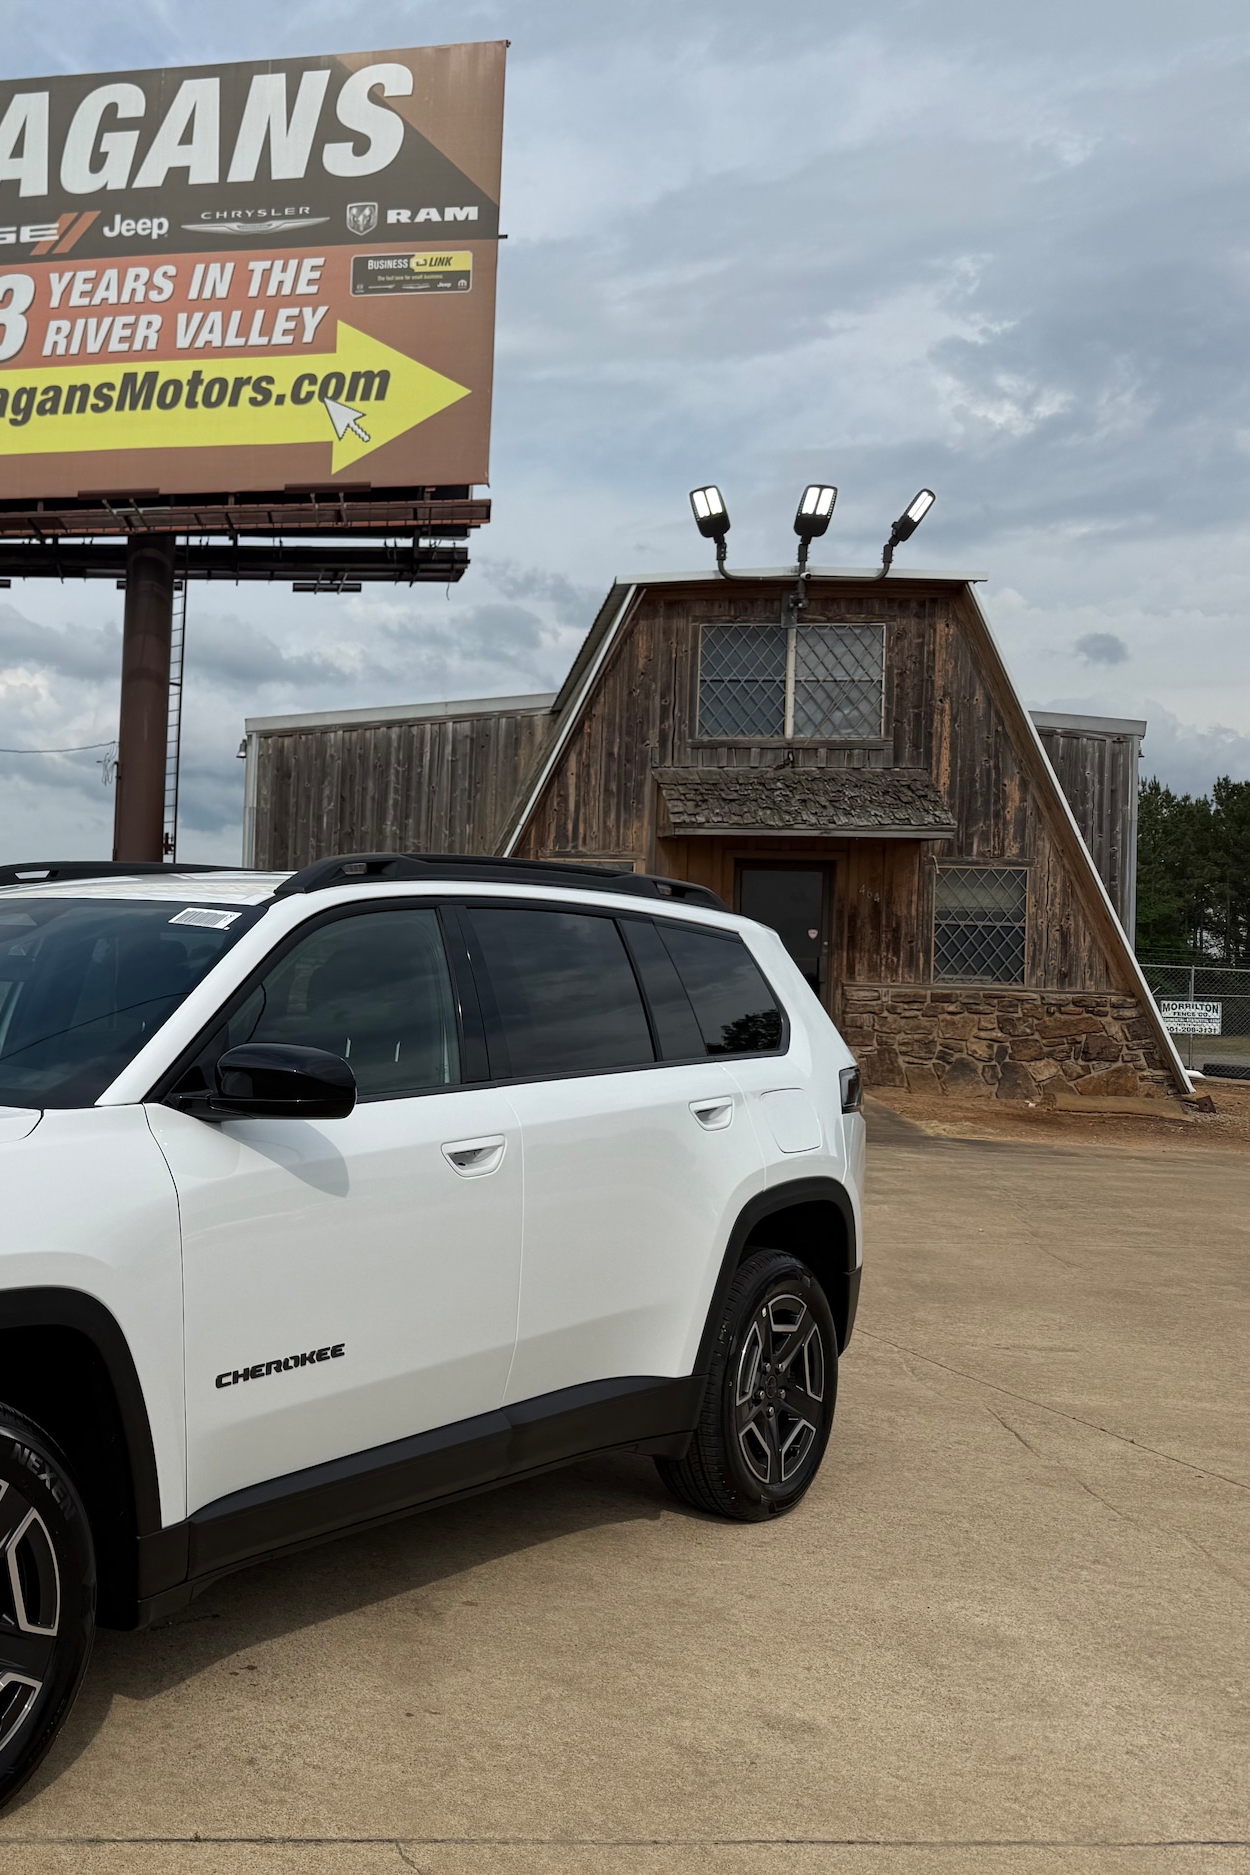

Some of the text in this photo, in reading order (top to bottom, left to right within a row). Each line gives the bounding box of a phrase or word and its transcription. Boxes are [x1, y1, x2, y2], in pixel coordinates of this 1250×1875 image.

[200, 206, 311, 220] CHRYSLER
[386, 205, 479, 225] RAM
[102, 214, 170, 240] Jeep
[367, 256, 453, 270] BUSINESS LINK
[48, 257, 326, 309] YEARS IN THE
[41, 305, 330, 357] RIVER VALLEY
[1163, 1003, 1218, 1014] MORRILTON
[215, 1342, 346, 1389] CHEROKEE
[9, 1442, 78, 1521] NEXEN
